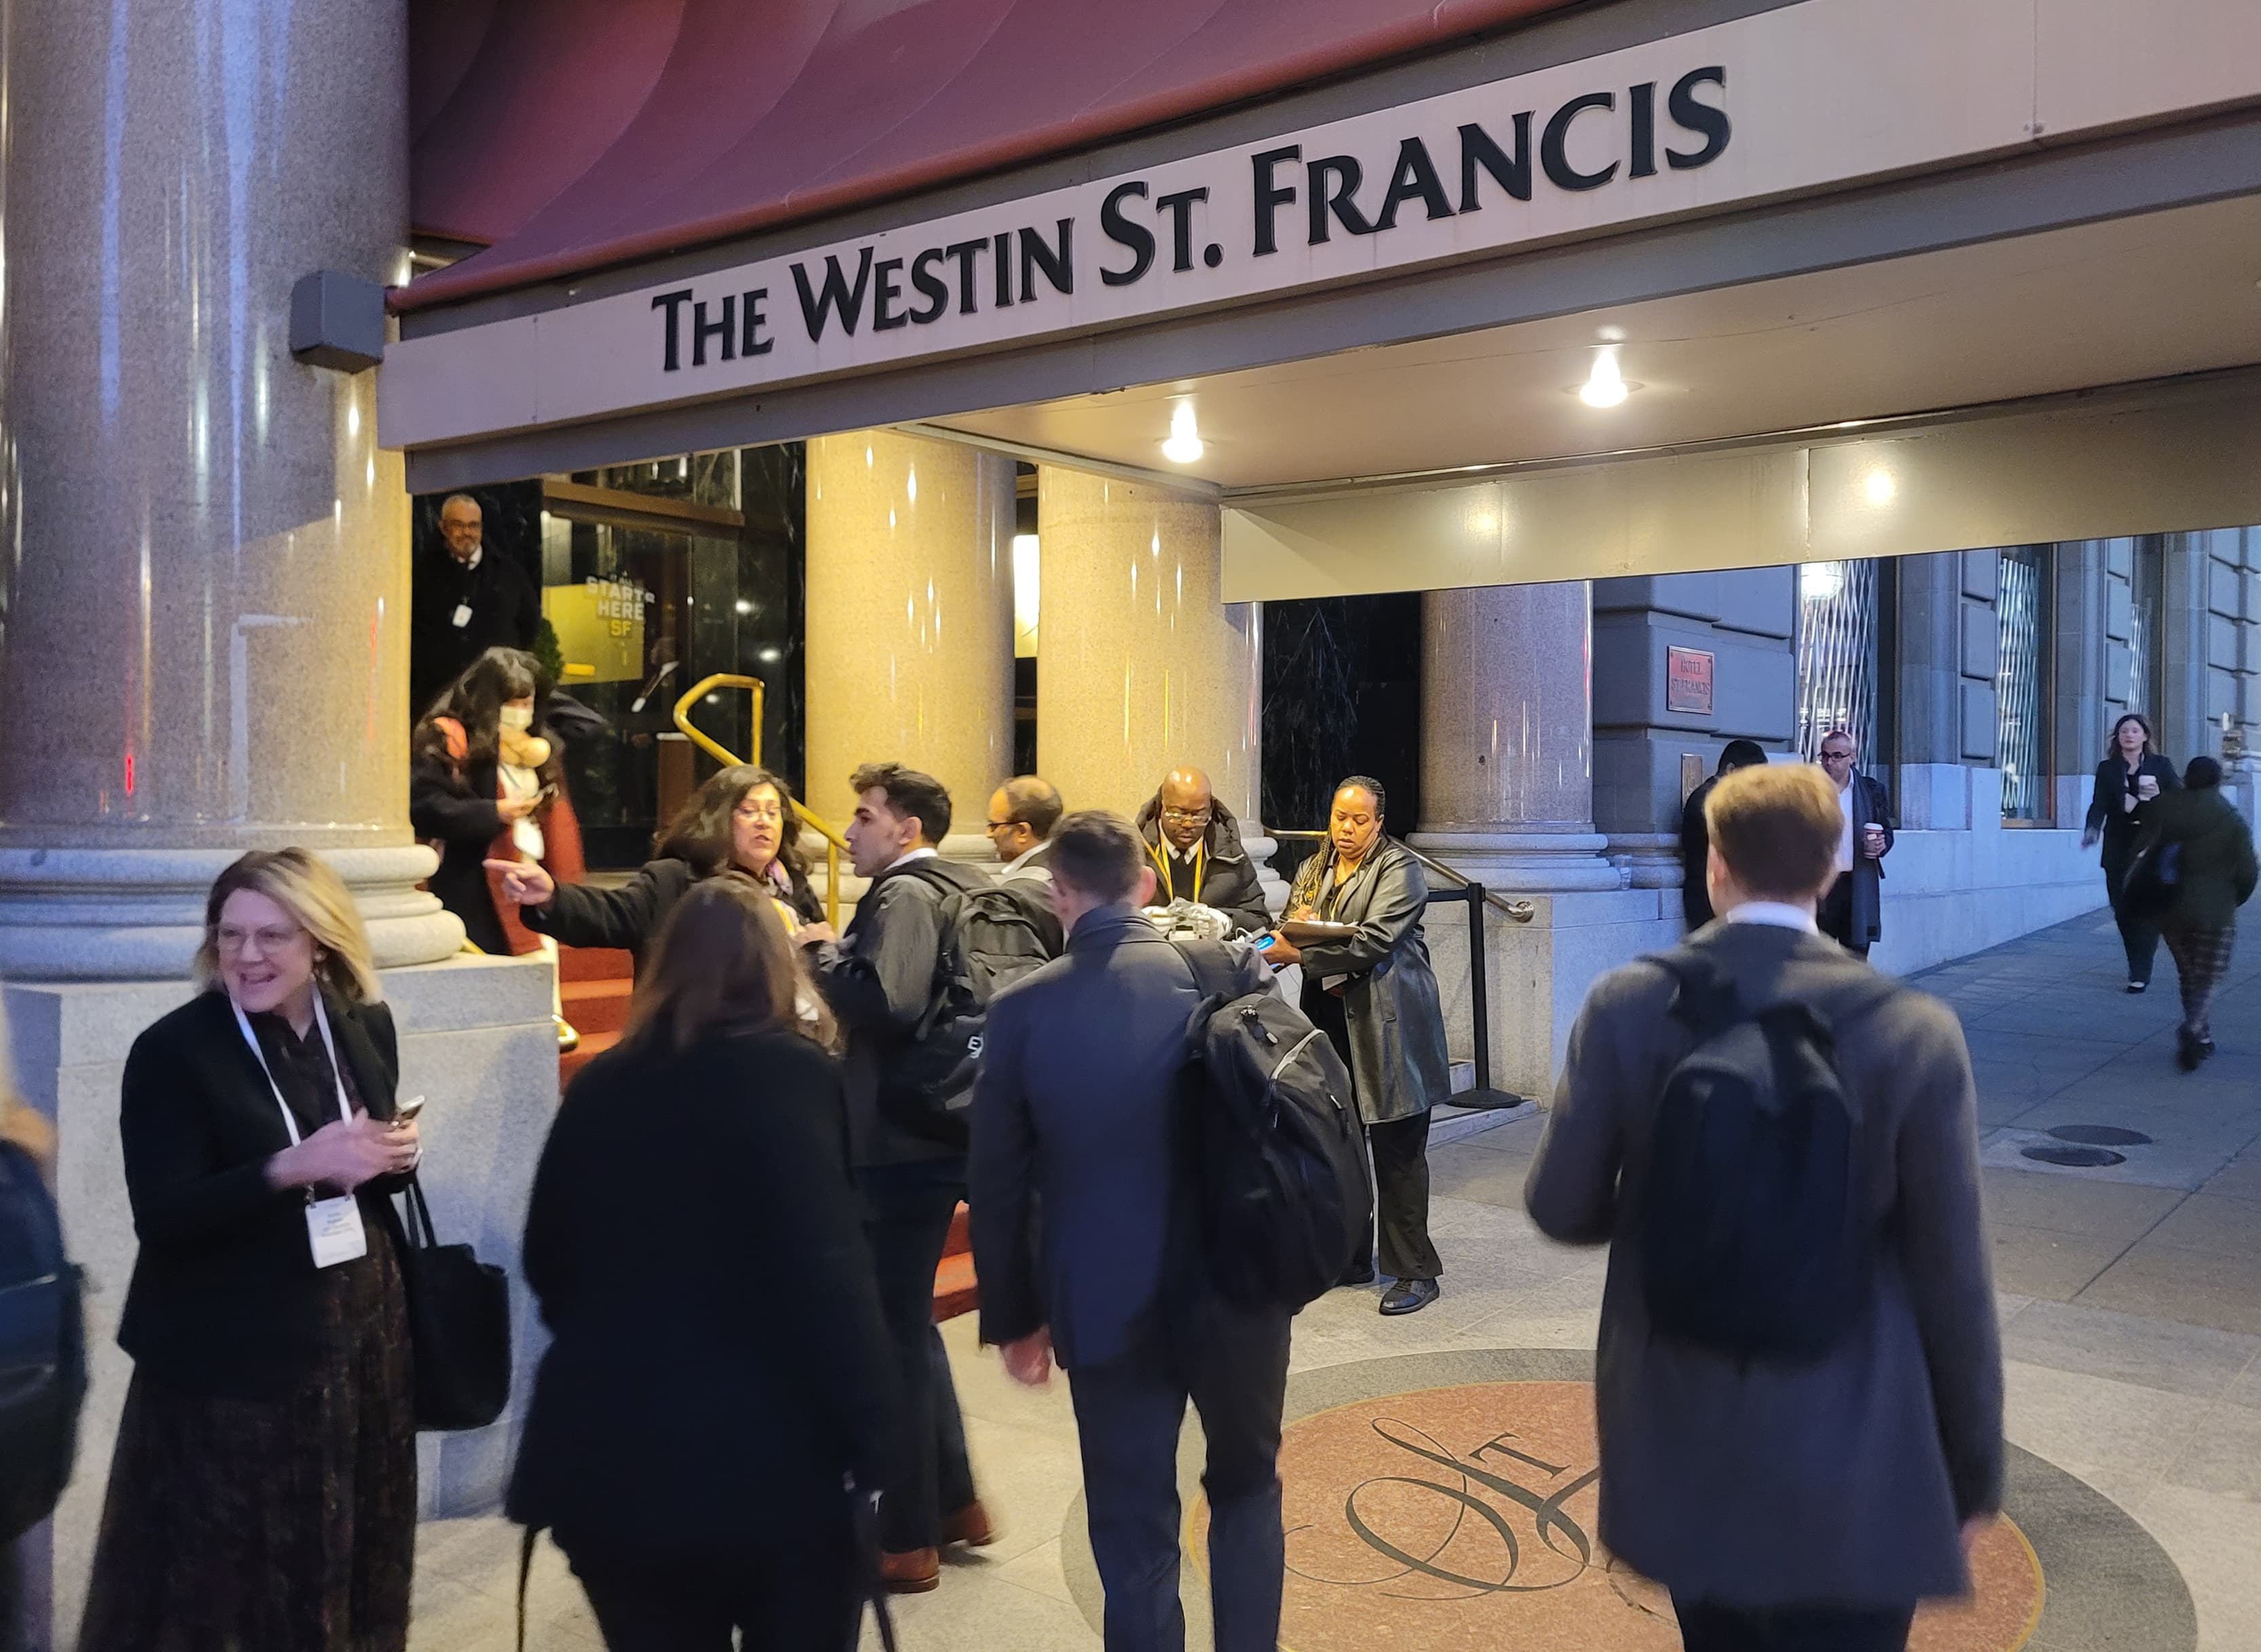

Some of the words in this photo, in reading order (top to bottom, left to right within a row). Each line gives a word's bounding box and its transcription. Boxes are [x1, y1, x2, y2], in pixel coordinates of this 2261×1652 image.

[651, 288, 774, 372] THE
[789, 218, 1075, 344] WESTIN
[1100, 181, 1223, 286] ST.
[1251, 66, 1732, 257] FRANCIS
[598, 600, 645, 621] HERE
[610, 618, 632, 637] SF
[1680, 658, 1703, 675] HOTEL
